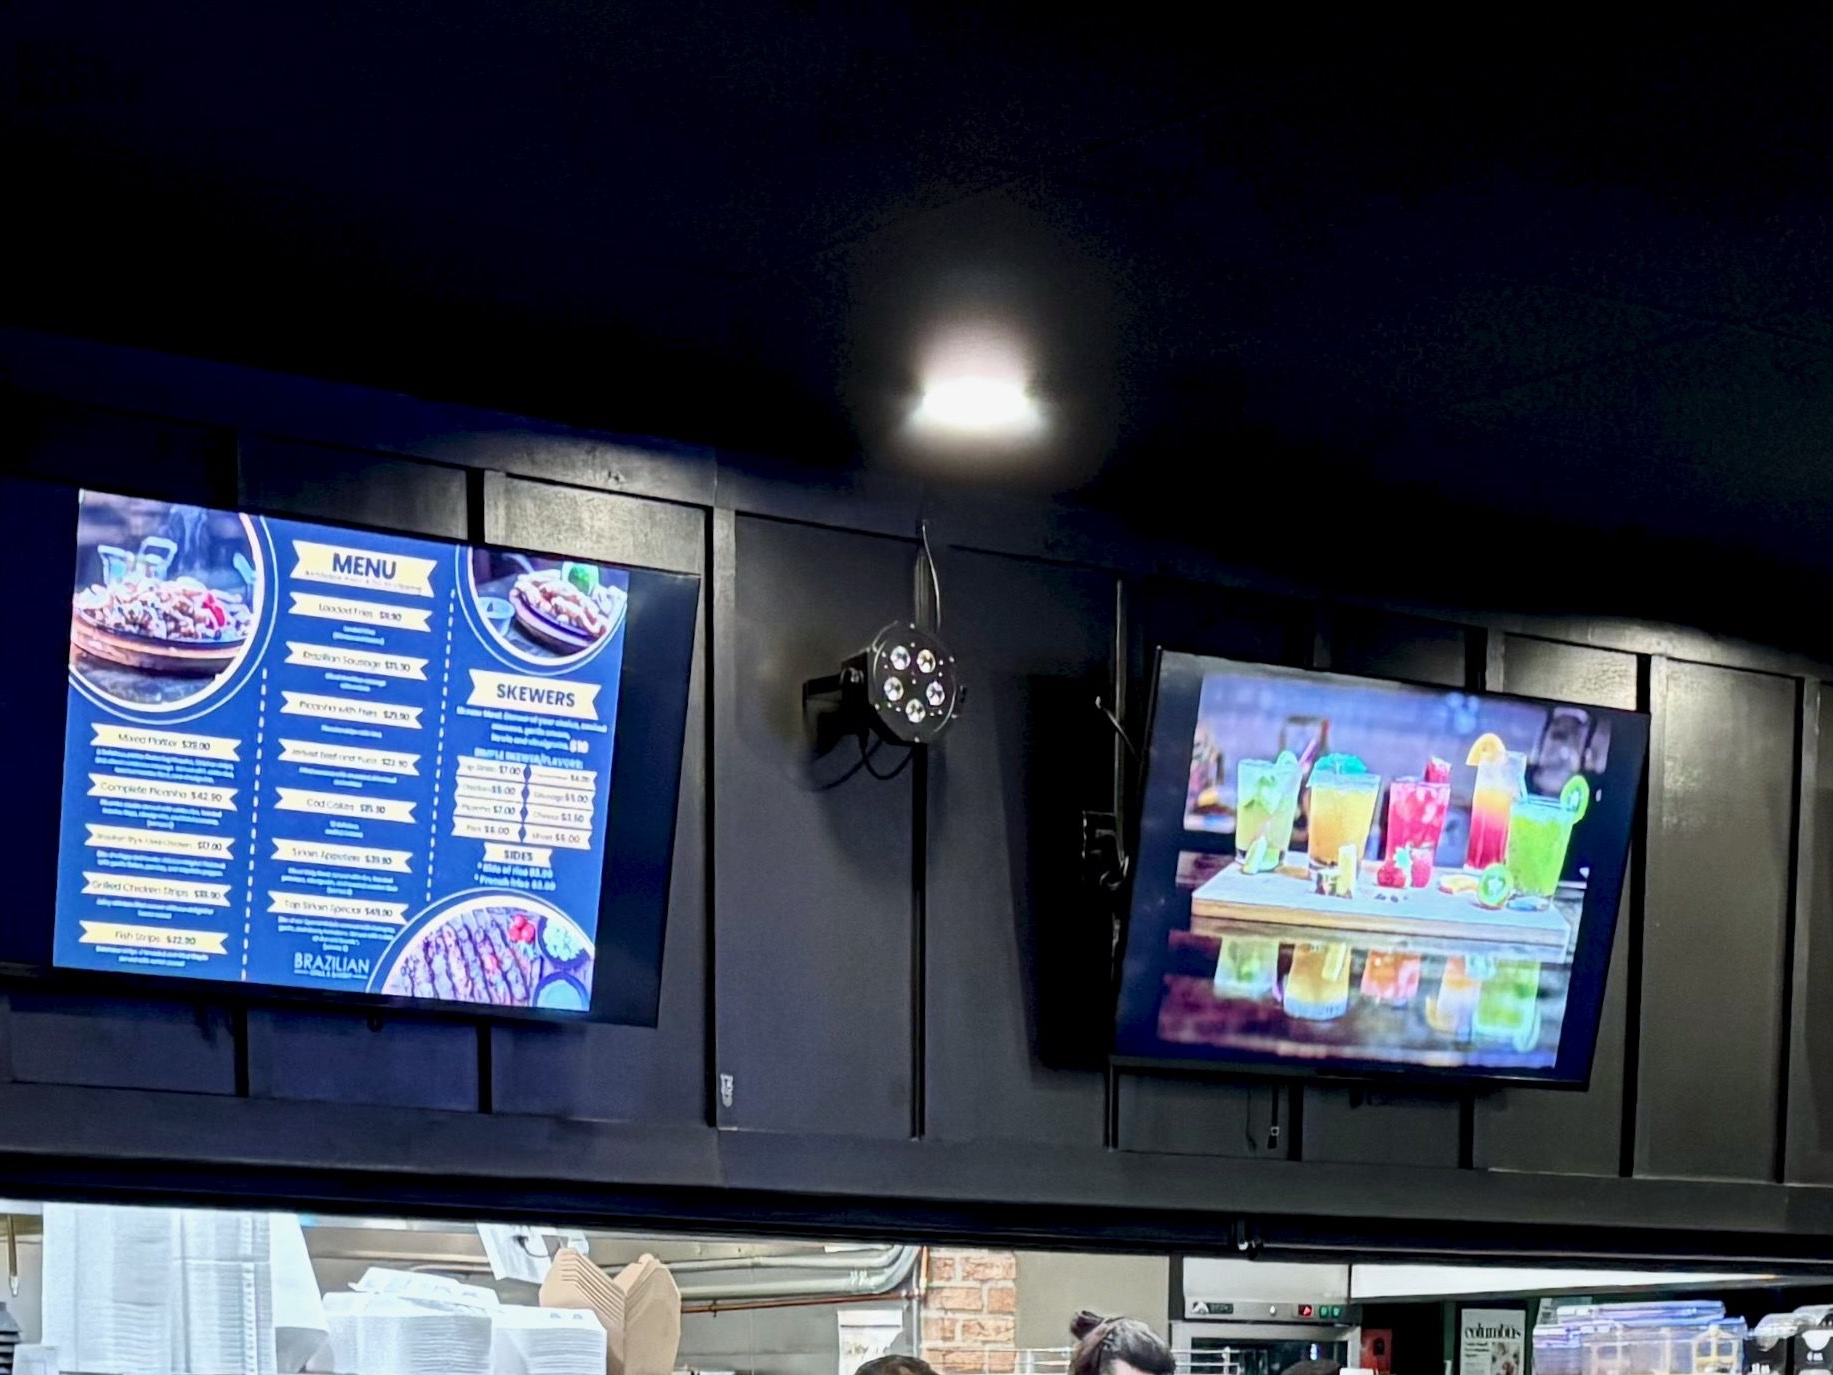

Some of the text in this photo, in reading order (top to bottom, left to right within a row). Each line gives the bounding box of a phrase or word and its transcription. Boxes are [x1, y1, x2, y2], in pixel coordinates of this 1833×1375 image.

[332, 553, 396, 579] MENU
[497, 683, 575, 708] SKEWERS
[294, 952, 370, 973] BRAZILIAN
